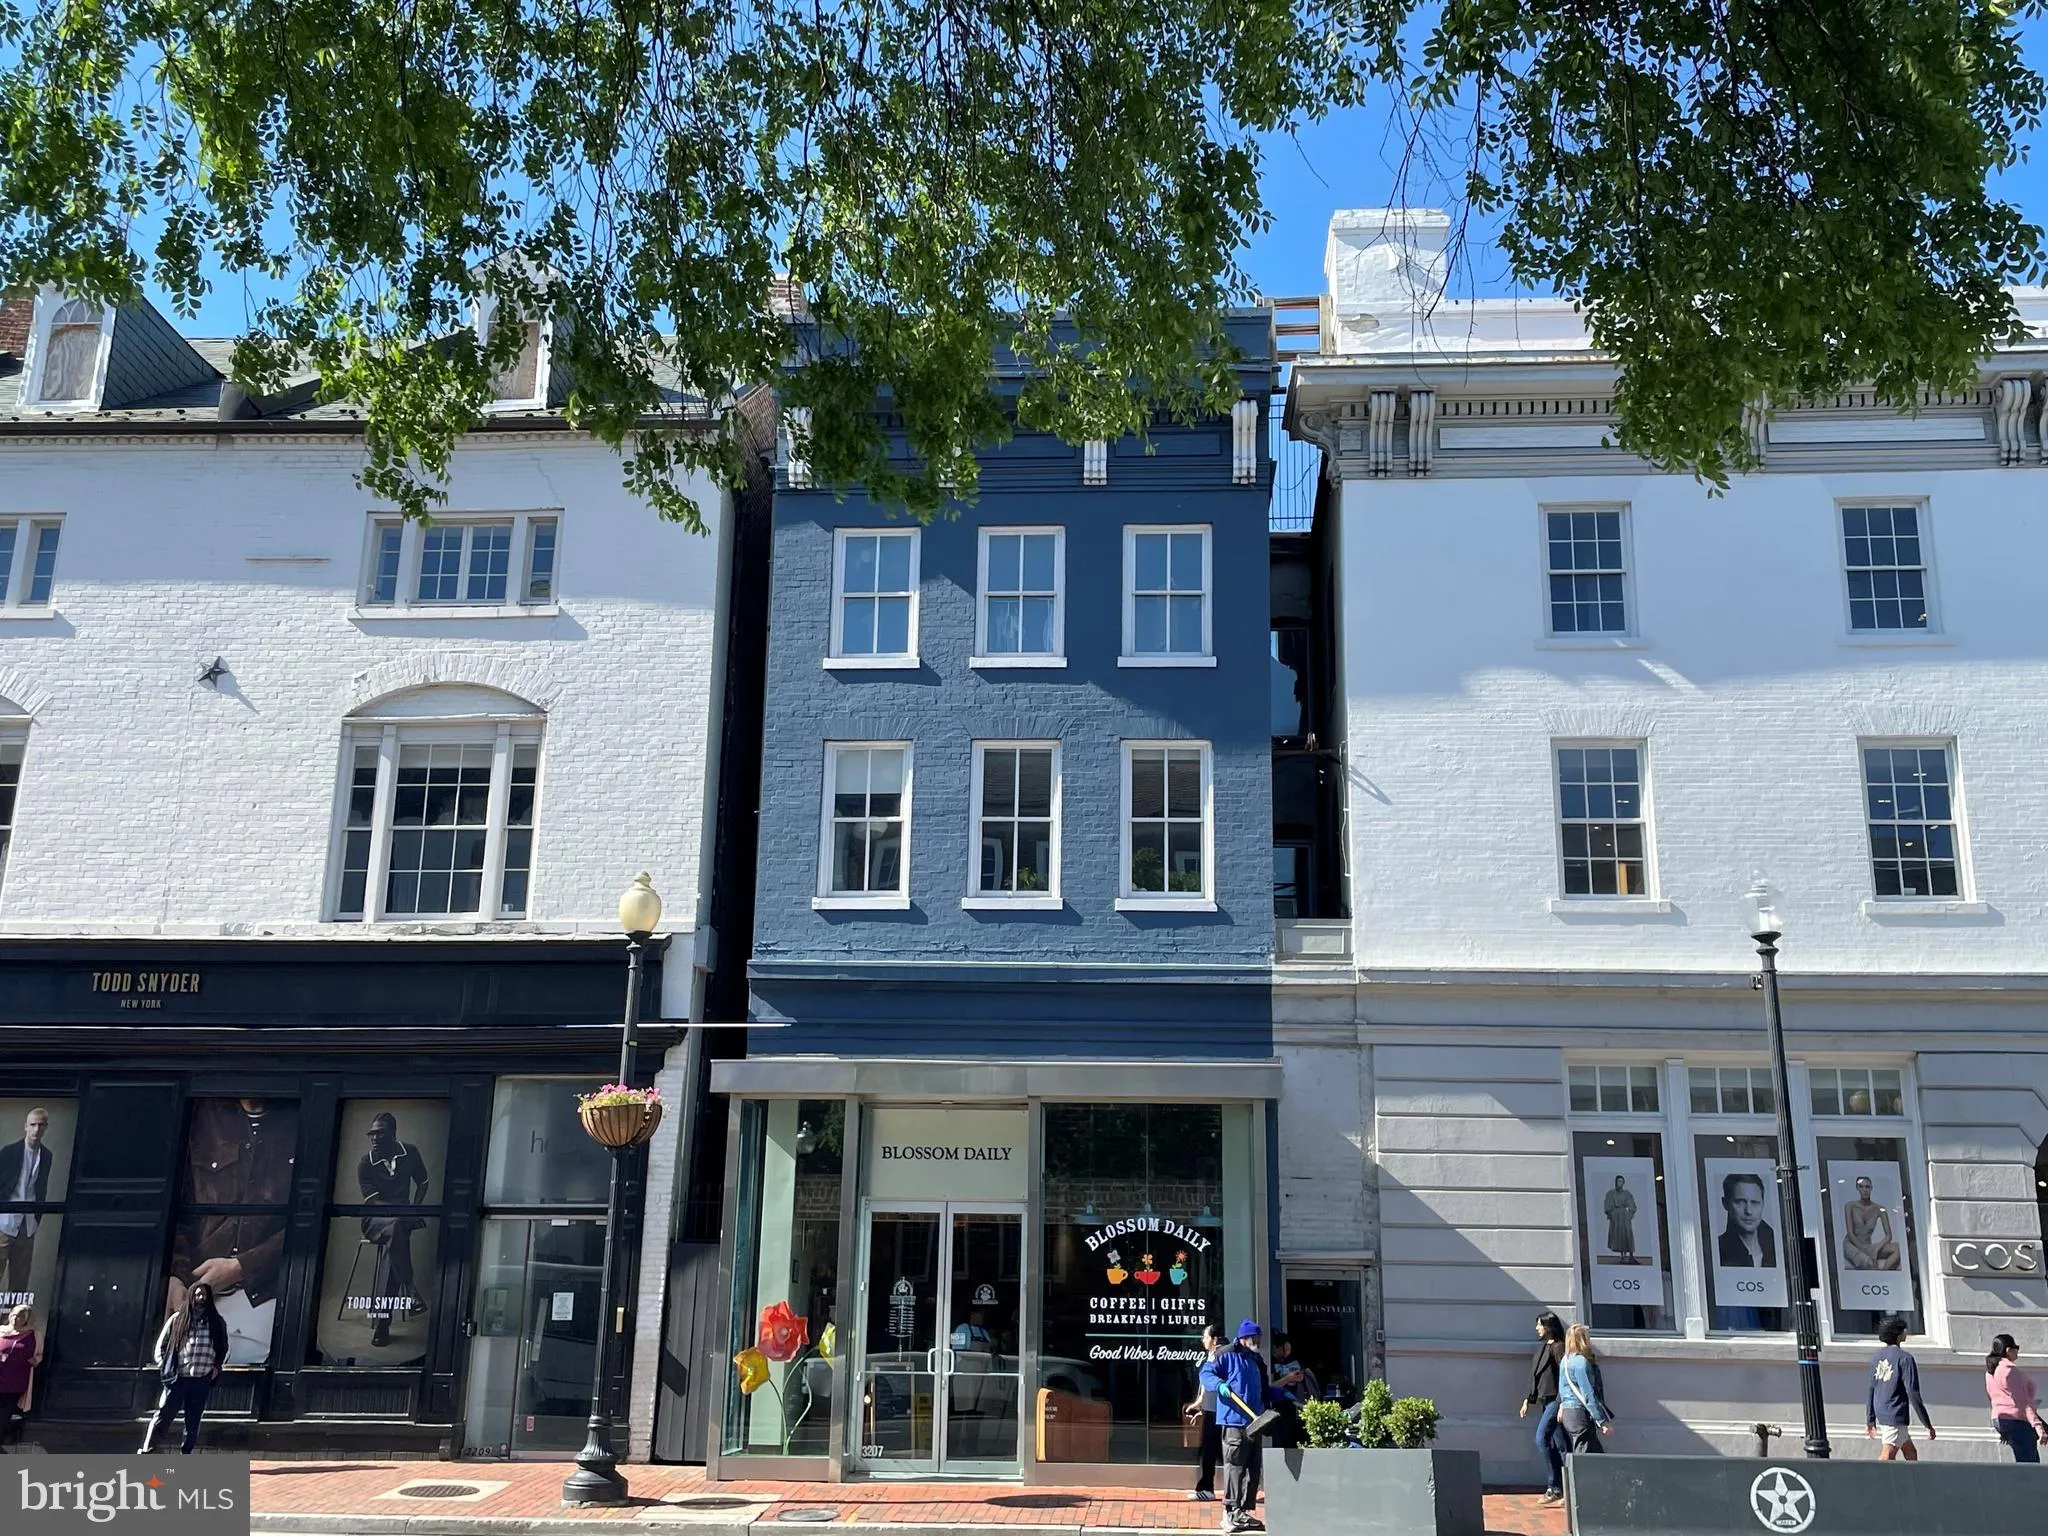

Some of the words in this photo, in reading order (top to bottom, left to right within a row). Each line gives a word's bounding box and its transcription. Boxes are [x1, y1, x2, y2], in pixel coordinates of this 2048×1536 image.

[92, 972, 132, 992] TODD
[137, 973, 200, 993] SNYDER
[120, 999, 138, 1009] NEW
[141, 999, 162, 1009] YORK
[881, 1145, 960, 1160] BLOSSOM
[963, 1147, 1013, 1160] DAILY
[1084, 1217, 1160, 1251] BLOSSOM
[1163, 1220, 1211, 1252] DAILY
[1952, 1242, 2037, 1271] COS
[1612, 1279, 1641, 1290] COS
[1736, 1281, 1765, 1292] COS
[1861, 1284, 1890, 1296] COS
[0, 1292, 35, 1305] SNYDER
[348, 1296, 372, 1309] TODD
[374, 1296, 412, 1310] SNYDER
[1089, 1297, 1146, 1310] COFFEE
[1160, 1298, 1206, 1310] GIFTS
[1089, 1314, 1158, 1324] BREAKFAST
[1168, 1315, 1206, 1325] LUNCH
[1089, 1345, 1123, 1360] Good
[1124, 1345, 1154, 1360] Vibes
[1157, 1346, 1207, 1367] Brewing
[862, 1445, 884, 1457] 3207
